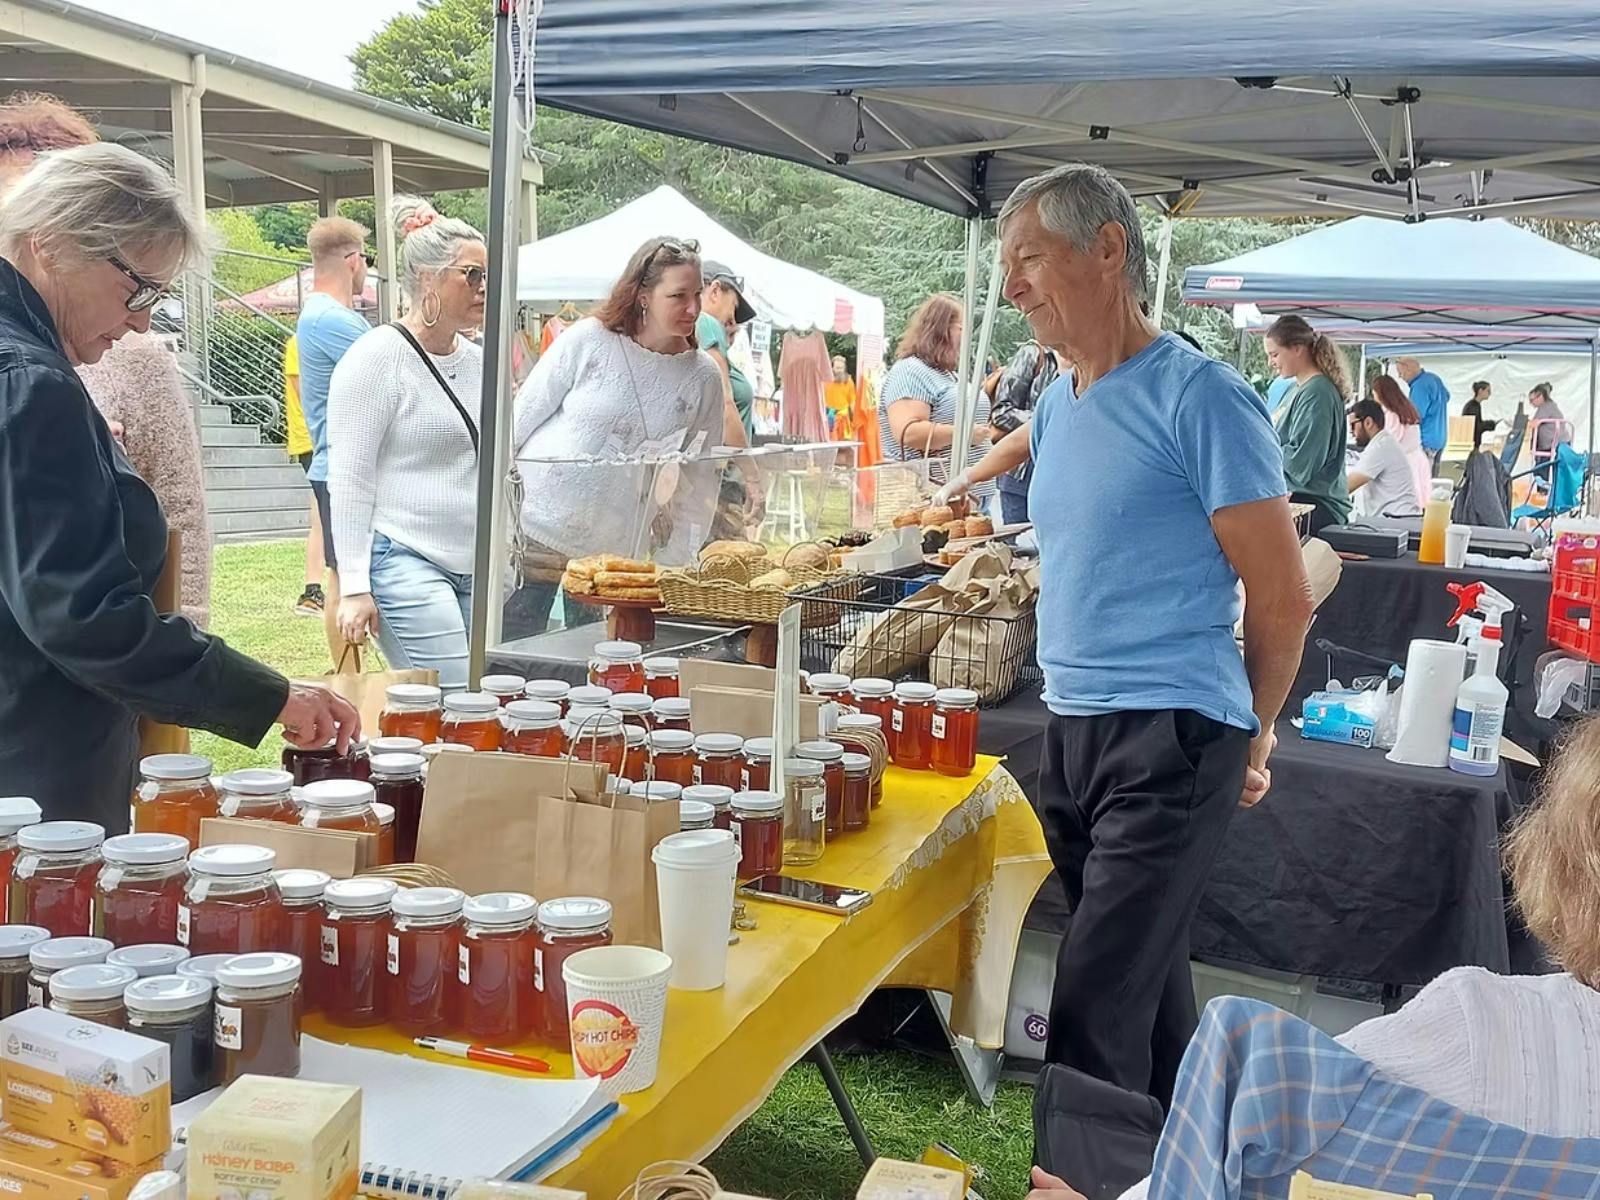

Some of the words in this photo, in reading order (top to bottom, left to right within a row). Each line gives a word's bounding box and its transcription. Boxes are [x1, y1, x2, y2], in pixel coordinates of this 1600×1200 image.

[1353, 727, 1370, 739] 100
[591, 1031, 608, 1043] HOT
[611, 1027, 637, 1041] CHIPS
[1028, 1021, 1046, 1037] 60
[0, 1177, 22, 1193] GES
